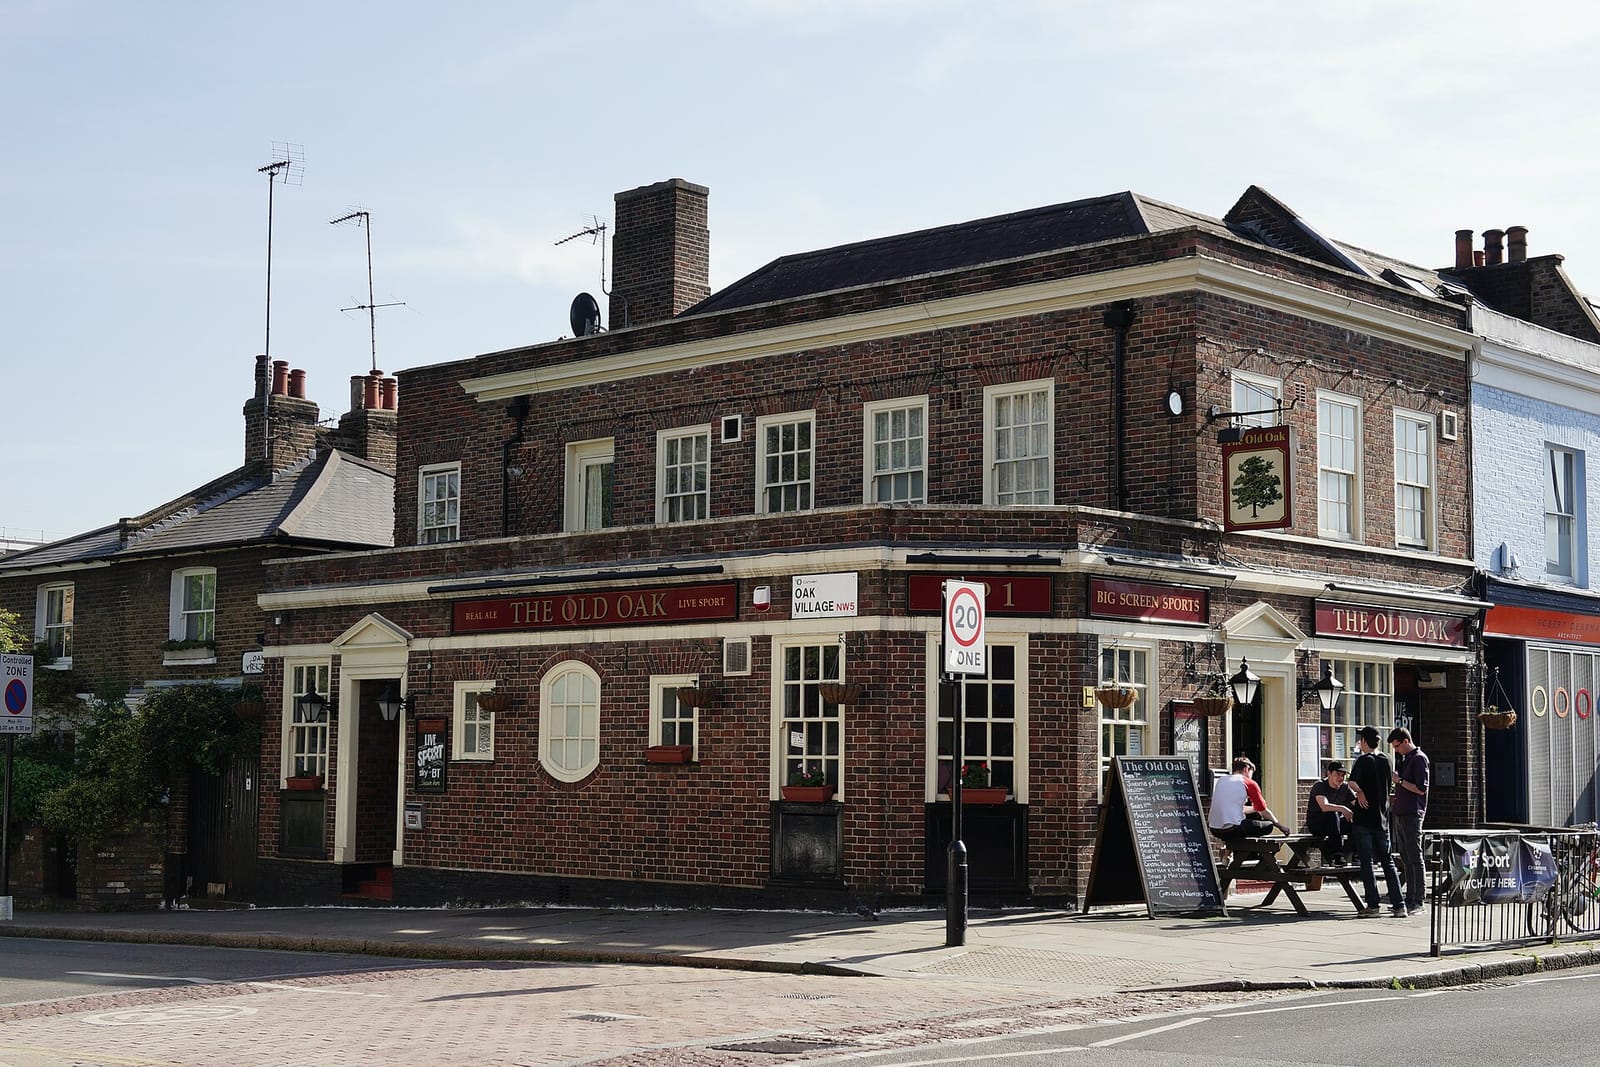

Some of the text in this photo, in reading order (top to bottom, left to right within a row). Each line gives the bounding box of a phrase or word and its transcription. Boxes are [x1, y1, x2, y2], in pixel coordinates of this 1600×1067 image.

[1245, 434, 1262, 444] Old
[1265, 432, 1286, 442] Oak
[795, 588, 815, 599] OAK
[1003, 582, 1015, 607] 1
[465, 593, 726, 623] REAL ALE THE OLD OAK LIVE SPORT
[795, 601, 855, 613] VILLAGE NW5
[1097, 590, 1200, 612] BIG SCREEN SPORTS
[955, 605, 978, 629] 20
[1332, 608, 1450, 641] THE OLD OAK
[2, 655, 32, 665] Controlled
[950, 650, 981, 666] ONE
[6, 666, 28, 676] ZONE
[1084, 688, 1094, 704] H
[424, 734, 437, 746] LIVE
[417, 745, 444, 767] SPORT
[431, 768, 441, 778] BT
[1123, 761, 1186, 771] The Old Oak
[1481, 852, 1510, 871] Sport
[1498, 877, 1517, 889] HERE
